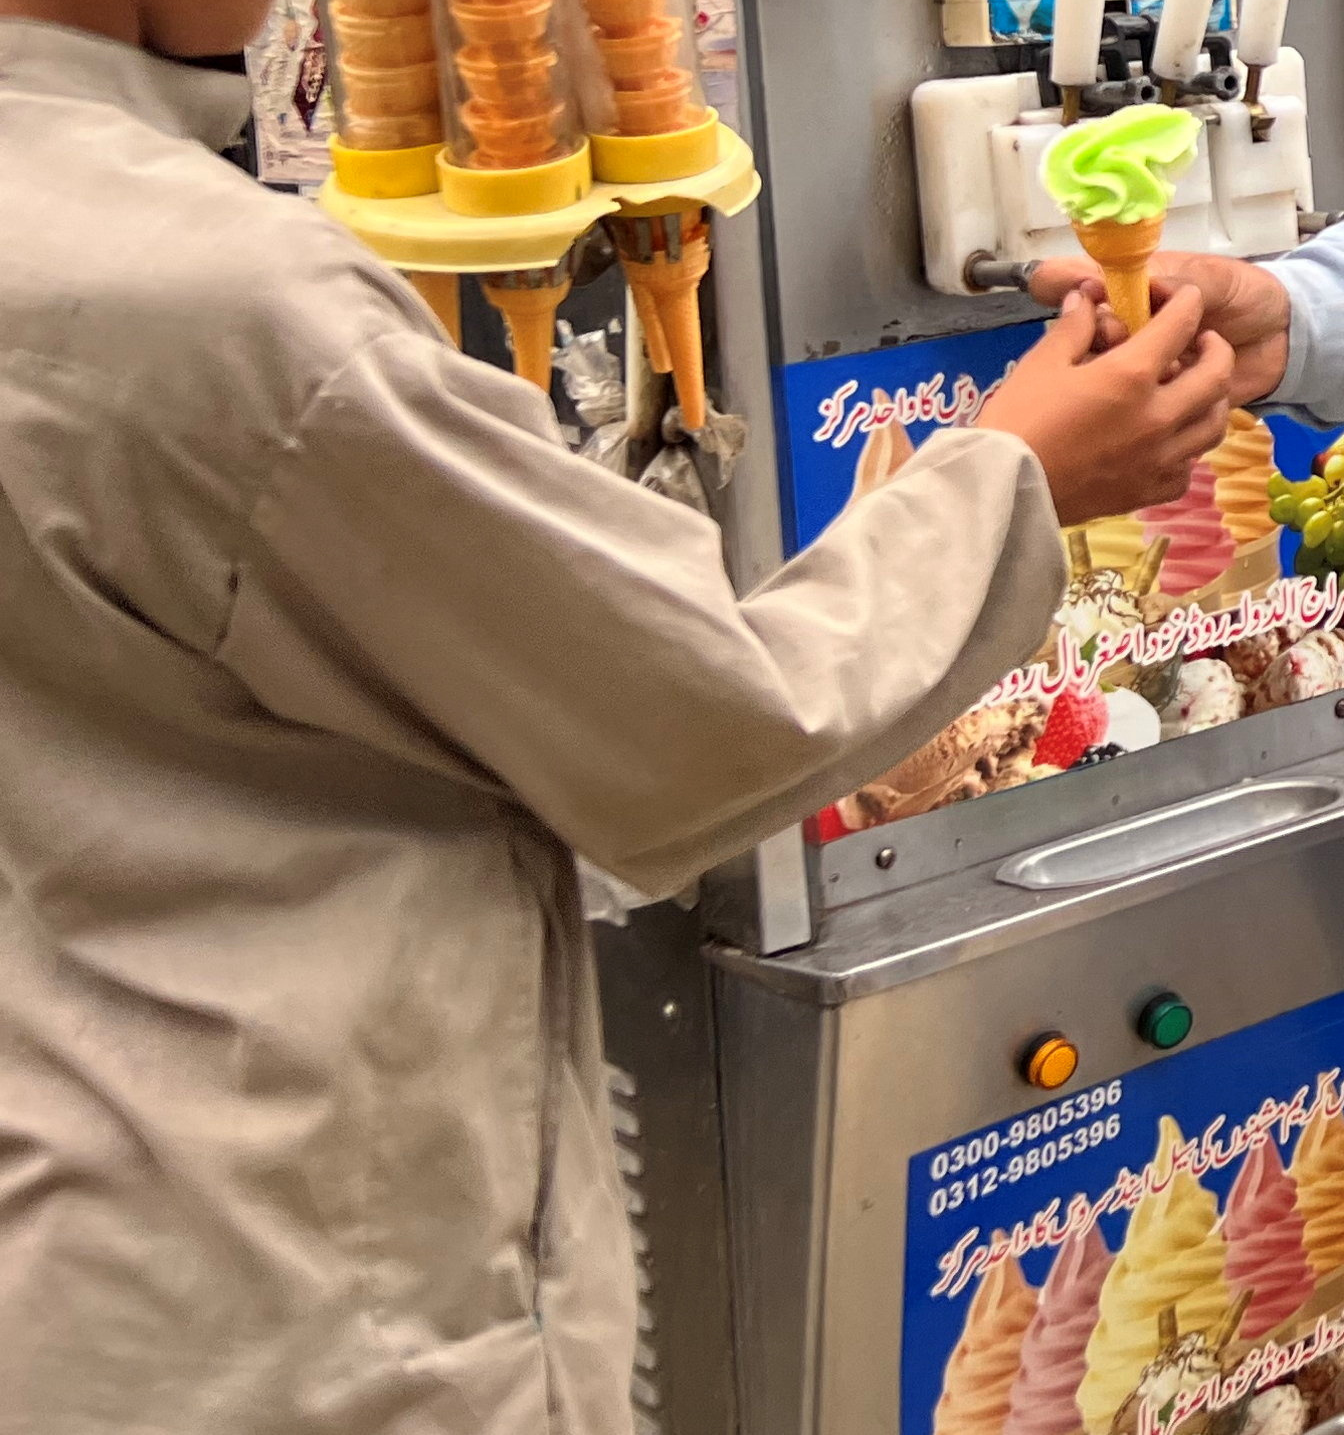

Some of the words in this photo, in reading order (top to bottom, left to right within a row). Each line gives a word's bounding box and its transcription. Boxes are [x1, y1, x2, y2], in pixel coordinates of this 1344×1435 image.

[813, 379, 870, 448] مرکز
[859, 387, 918, 432] واحد
[914, 372, 945, 422] کا
[1184, 602, 1231, 654] روڈ
[930, 1079, 1123, 1181] 0300-9805396
[1280, 1067, 1342, 1144] کریم
[929, 1113, 1122, 1217] 0312-9805396
[1151, 1136, 1199, 1195] سیل
[1192, 1114, 1226, 1177] کی
[1031, 1197, 1061, 1248] کا
[1049, 1185, 1116, 1246] سروس
[930, 1226, 989, 1299] مرکز
[976, 1220, 1034, 1276] واحد
[1254, 1340, 1306, 1389] روڈ
